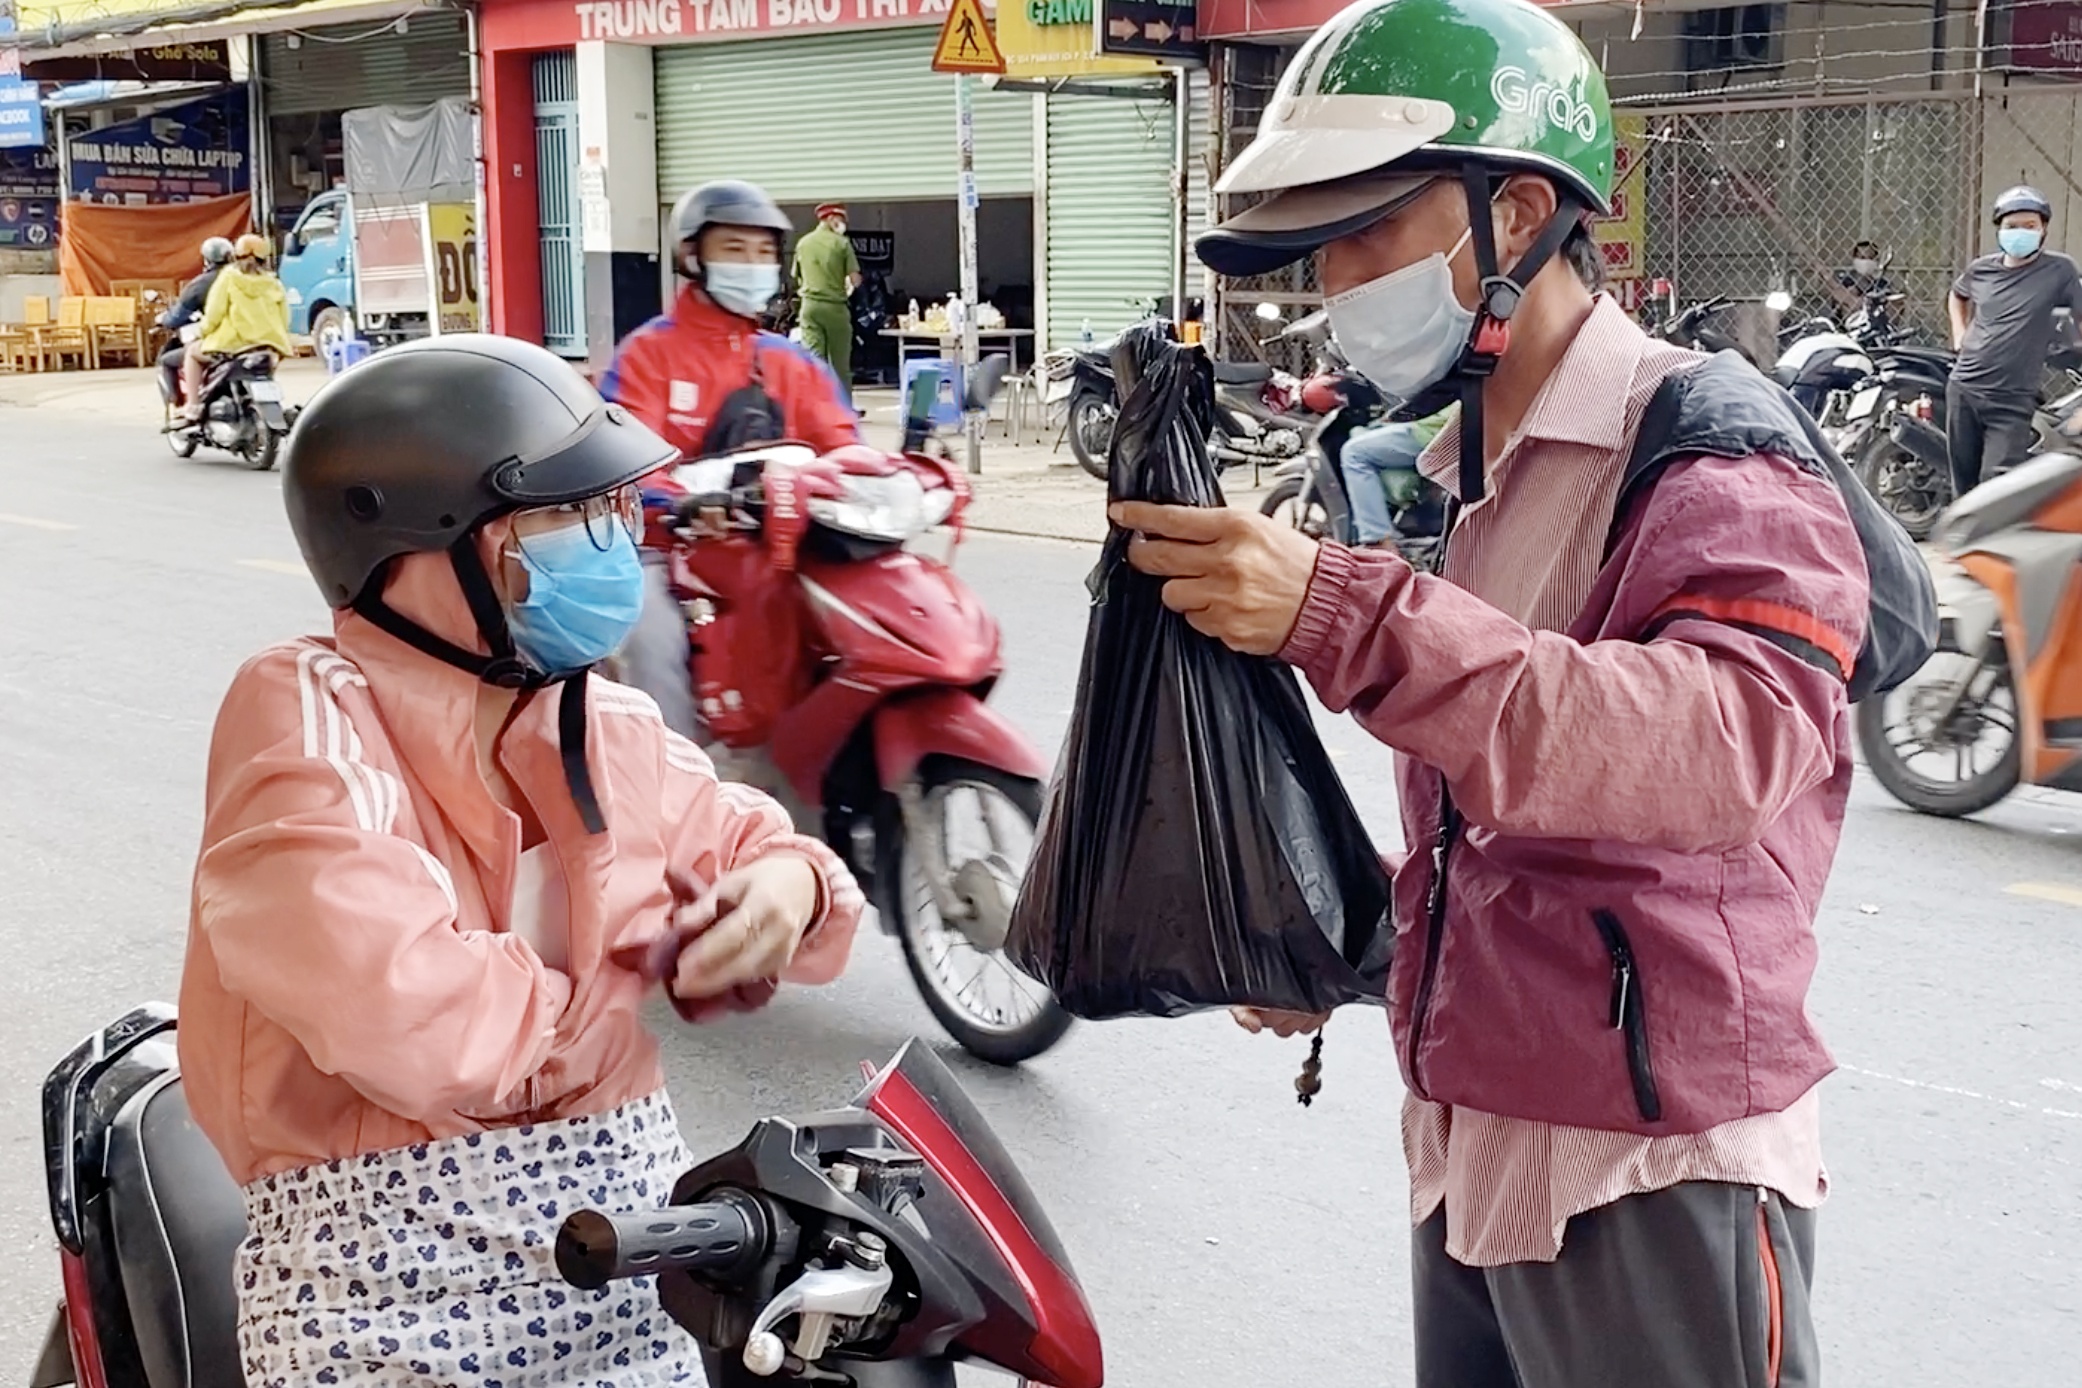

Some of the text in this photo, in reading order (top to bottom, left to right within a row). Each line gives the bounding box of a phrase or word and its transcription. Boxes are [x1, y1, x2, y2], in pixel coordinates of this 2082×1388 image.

[575, 1, 681, 38] TRUNG
[1490, 55, 1598, 142] Grab
[71, 143, 101, 162] MUA
[198, 150, 244, 168] LAPTOP
